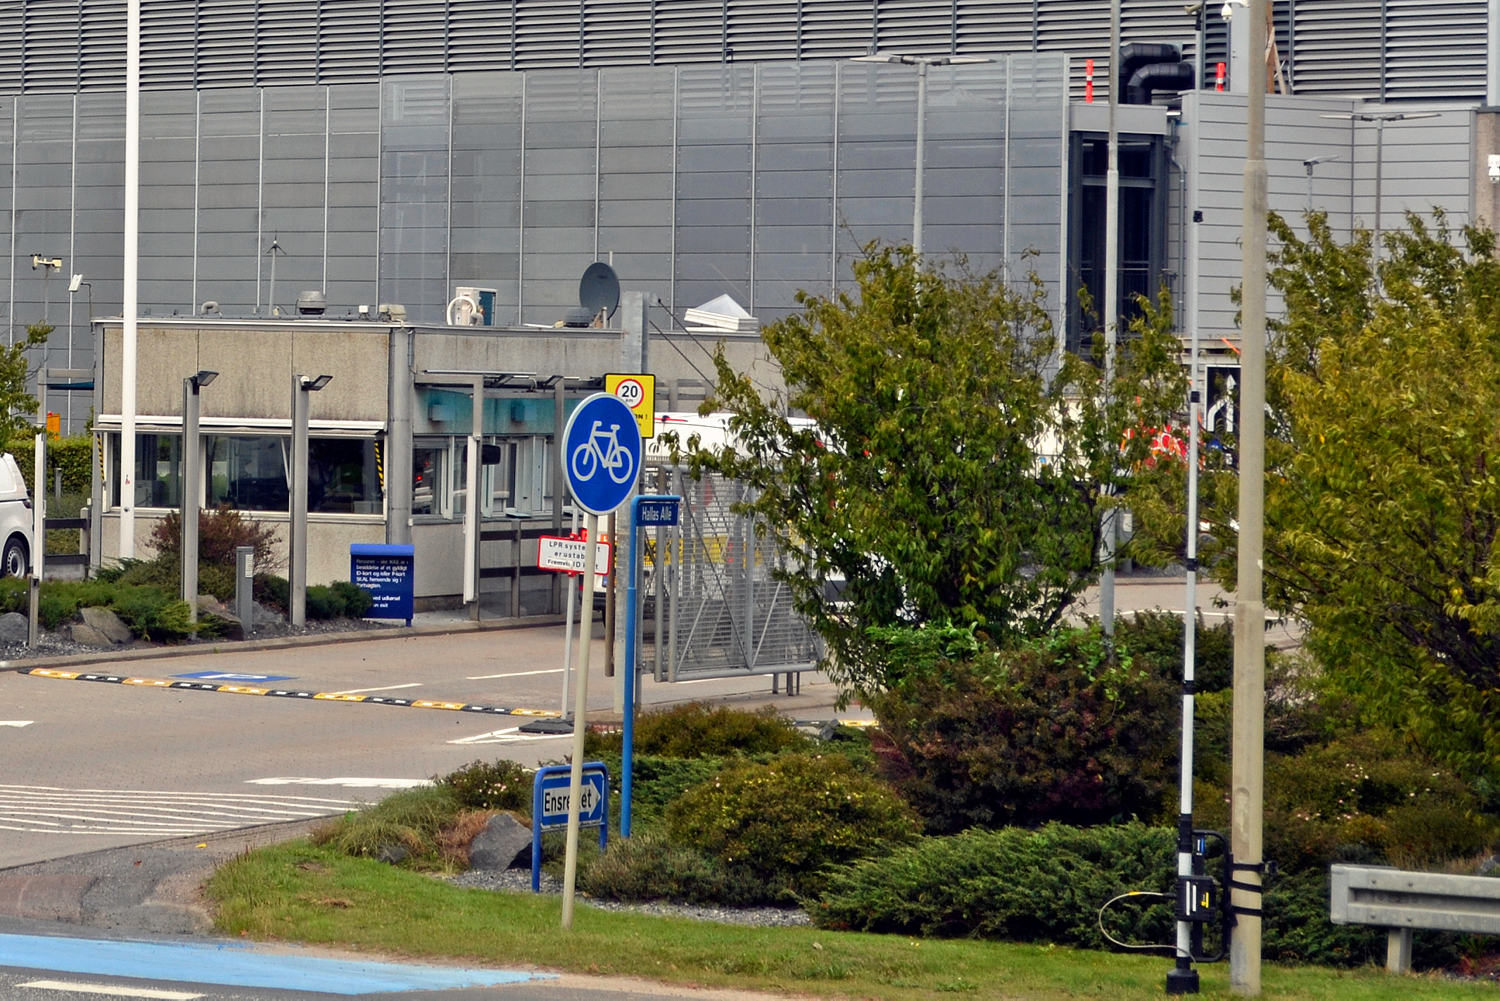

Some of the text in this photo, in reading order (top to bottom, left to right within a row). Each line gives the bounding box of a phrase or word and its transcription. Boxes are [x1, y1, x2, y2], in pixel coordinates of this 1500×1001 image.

[621, 385, 638, 398] 20
[642, 505, 672, 521] Hallas Allé
[549, 541, 601, 553] LPR systet
[544, 789, 591, 812] Ensreet
